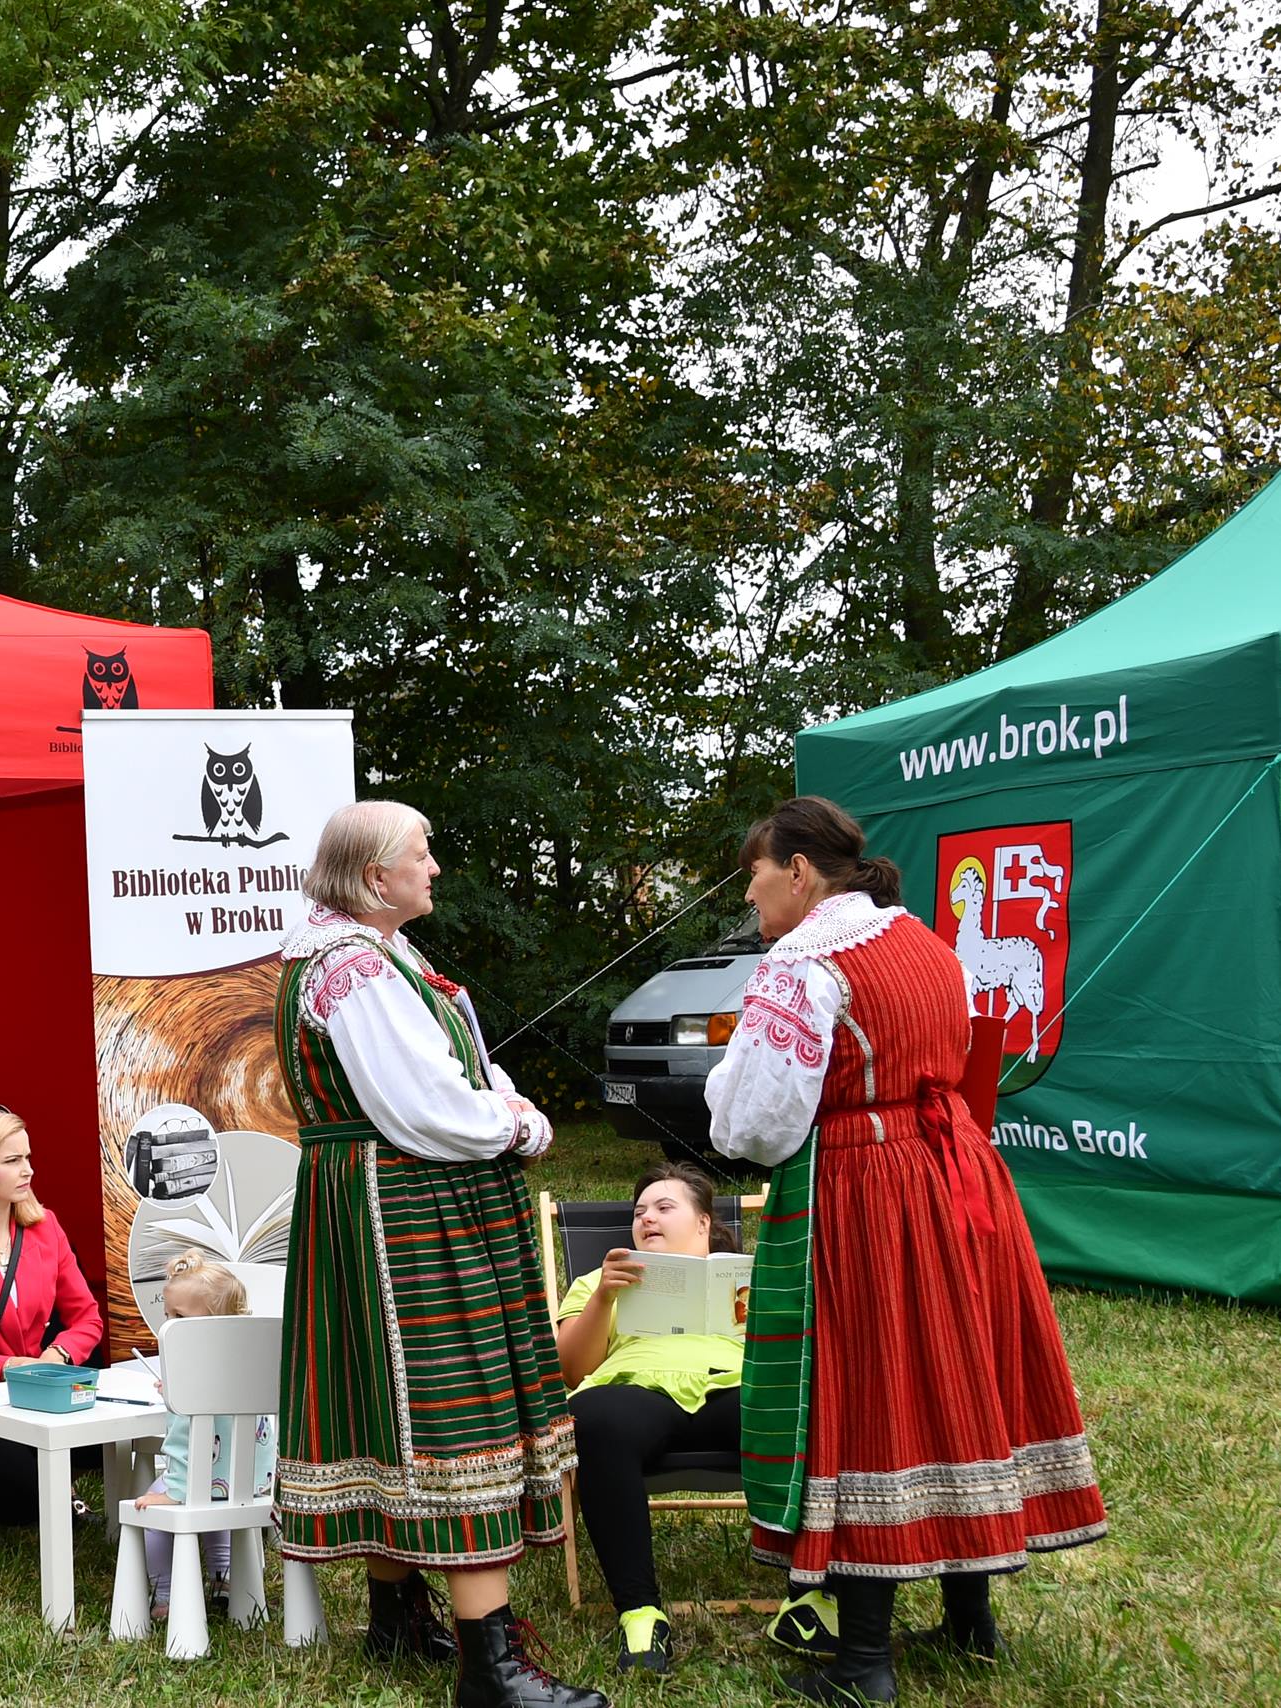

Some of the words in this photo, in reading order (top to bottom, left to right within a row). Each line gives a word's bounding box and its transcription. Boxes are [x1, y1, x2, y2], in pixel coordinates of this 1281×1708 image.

[900, 695, 1128, 781] www.brok.pl
[112, 868, 230, 898] Biblioteka
[185, 912, 203, 935] w
[211, 905, 284, 934] Broku
[1072, 1120, 1148, 1159] Brok
